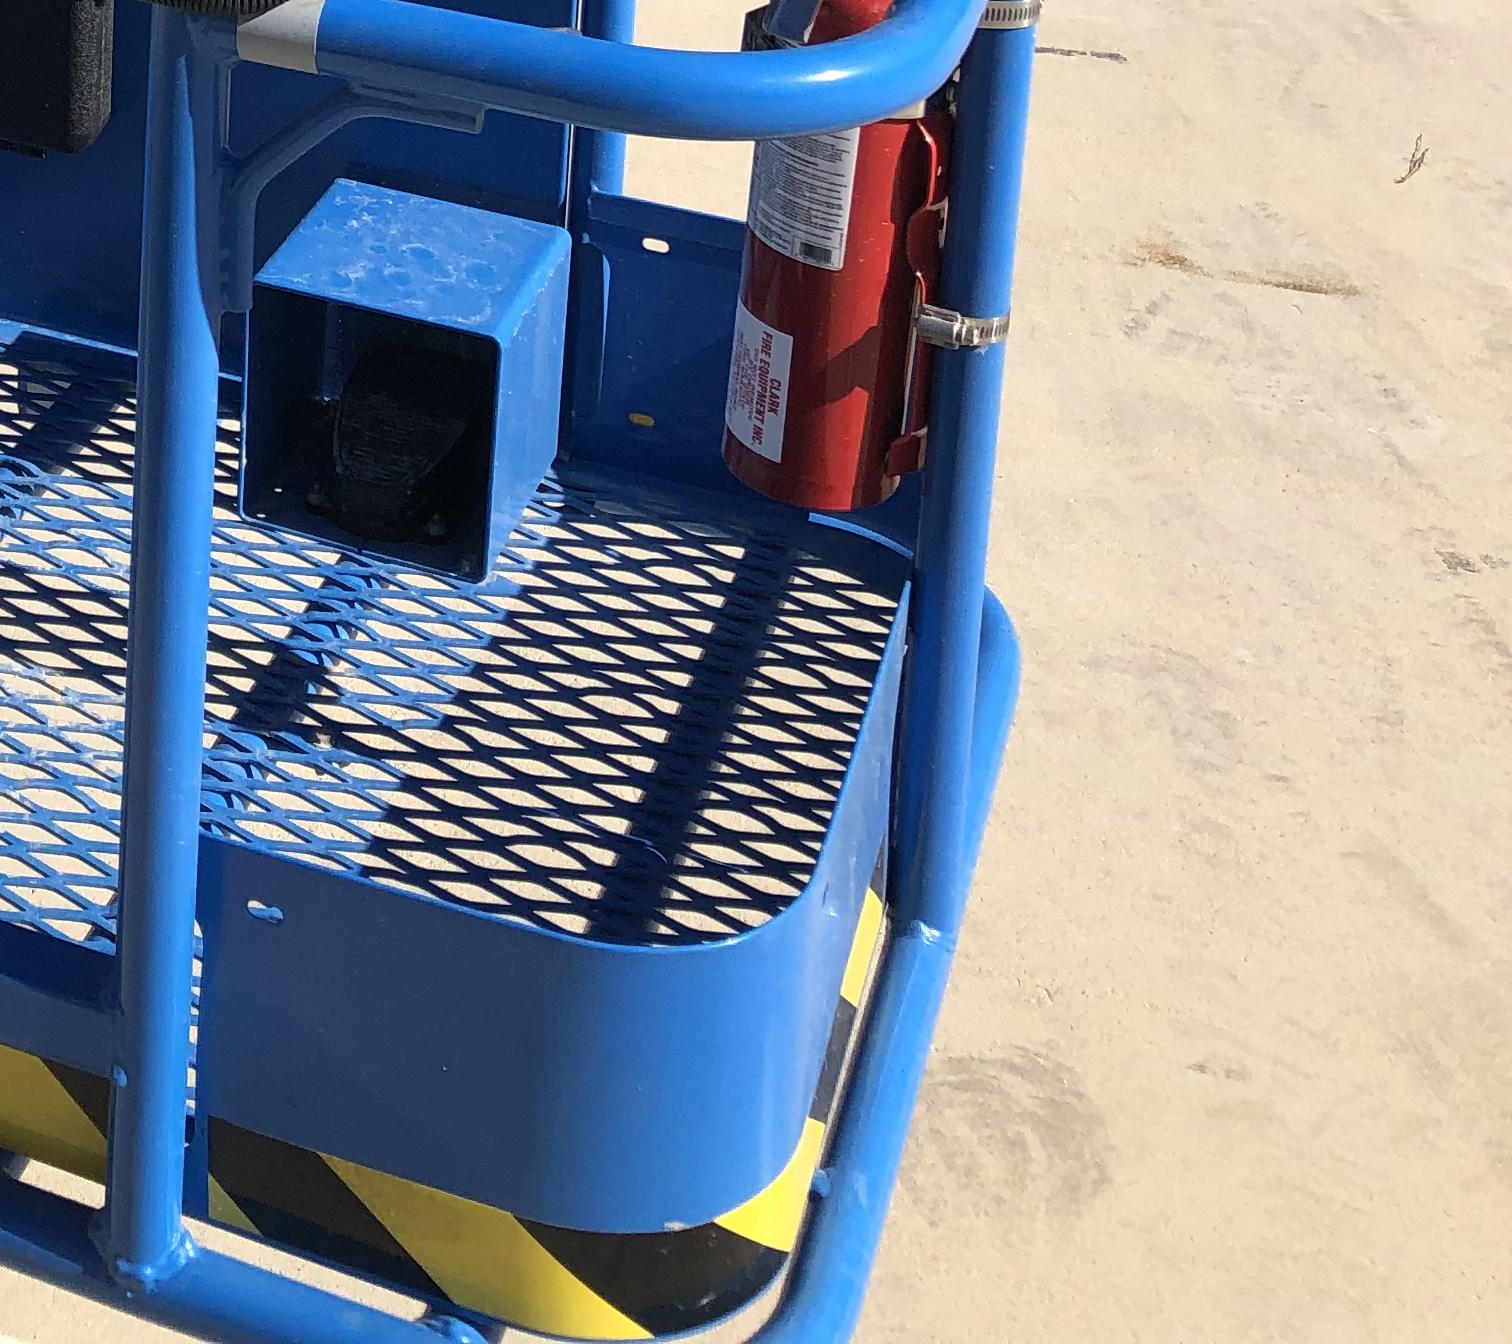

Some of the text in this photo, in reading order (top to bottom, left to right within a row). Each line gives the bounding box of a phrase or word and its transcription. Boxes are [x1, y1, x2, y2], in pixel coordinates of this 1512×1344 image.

[760, 330, 773, 359] FIRE
[754, 359, 770, 424] EQUIPMENT
[768, 378, 782, 416] CLARK
